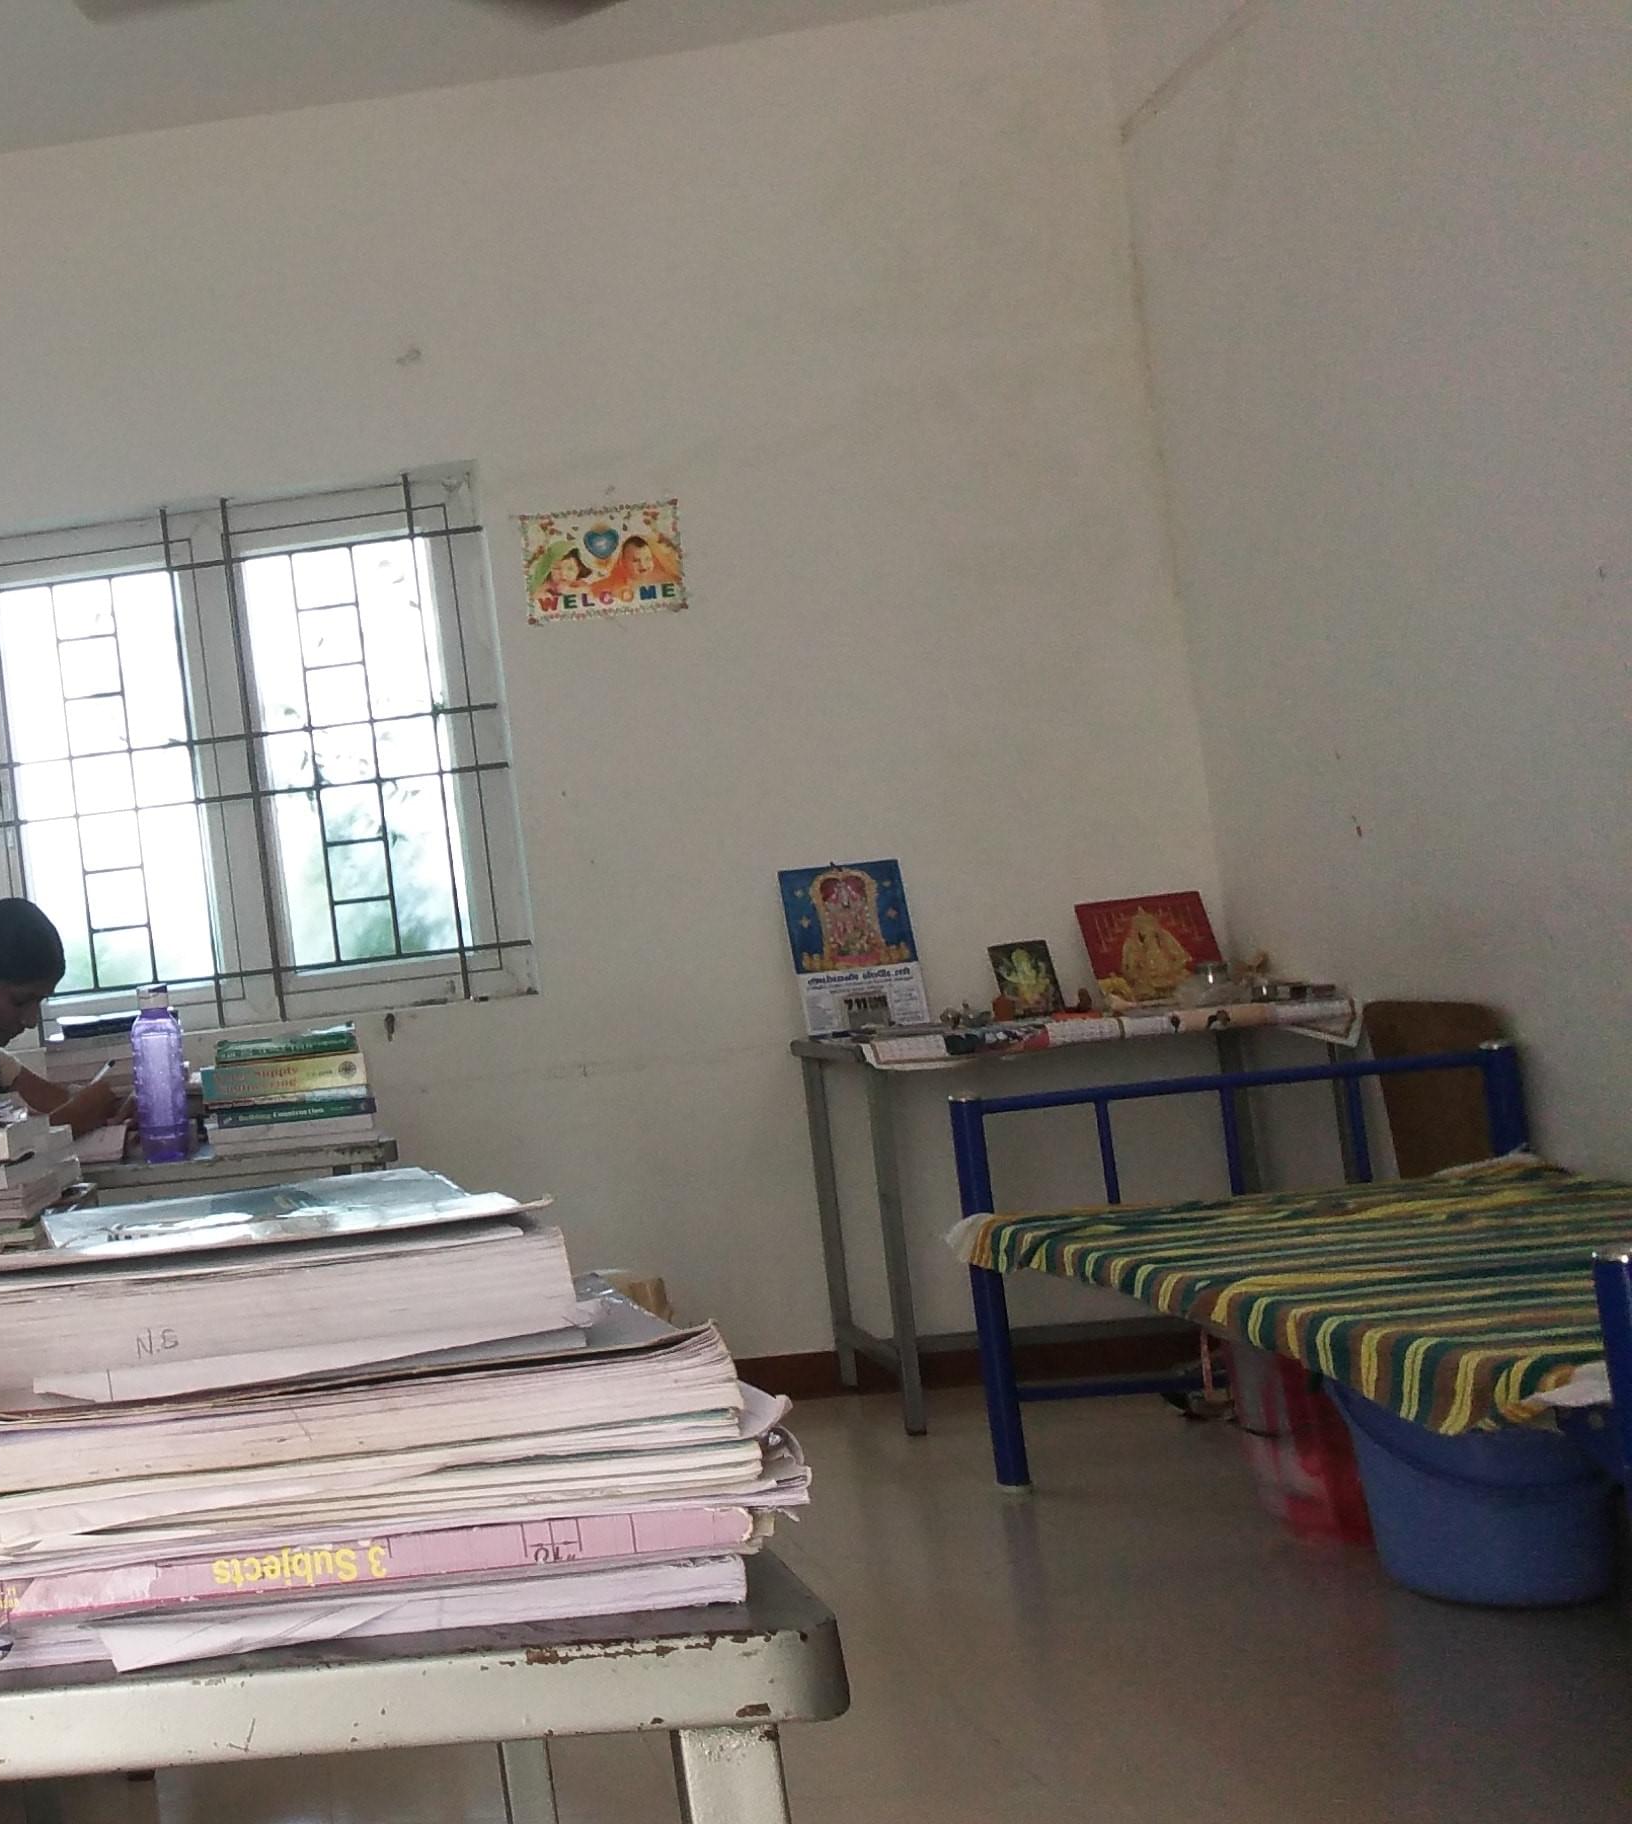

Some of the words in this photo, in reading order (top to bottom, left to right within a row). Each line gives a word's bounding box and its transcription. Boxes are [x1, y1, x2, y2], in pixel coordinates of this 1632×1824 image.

[538, 584, 676, 612] WELCOME
[213, 1546, 358, 1588] Subjects
[368, 1545, 387, 1578] 3
